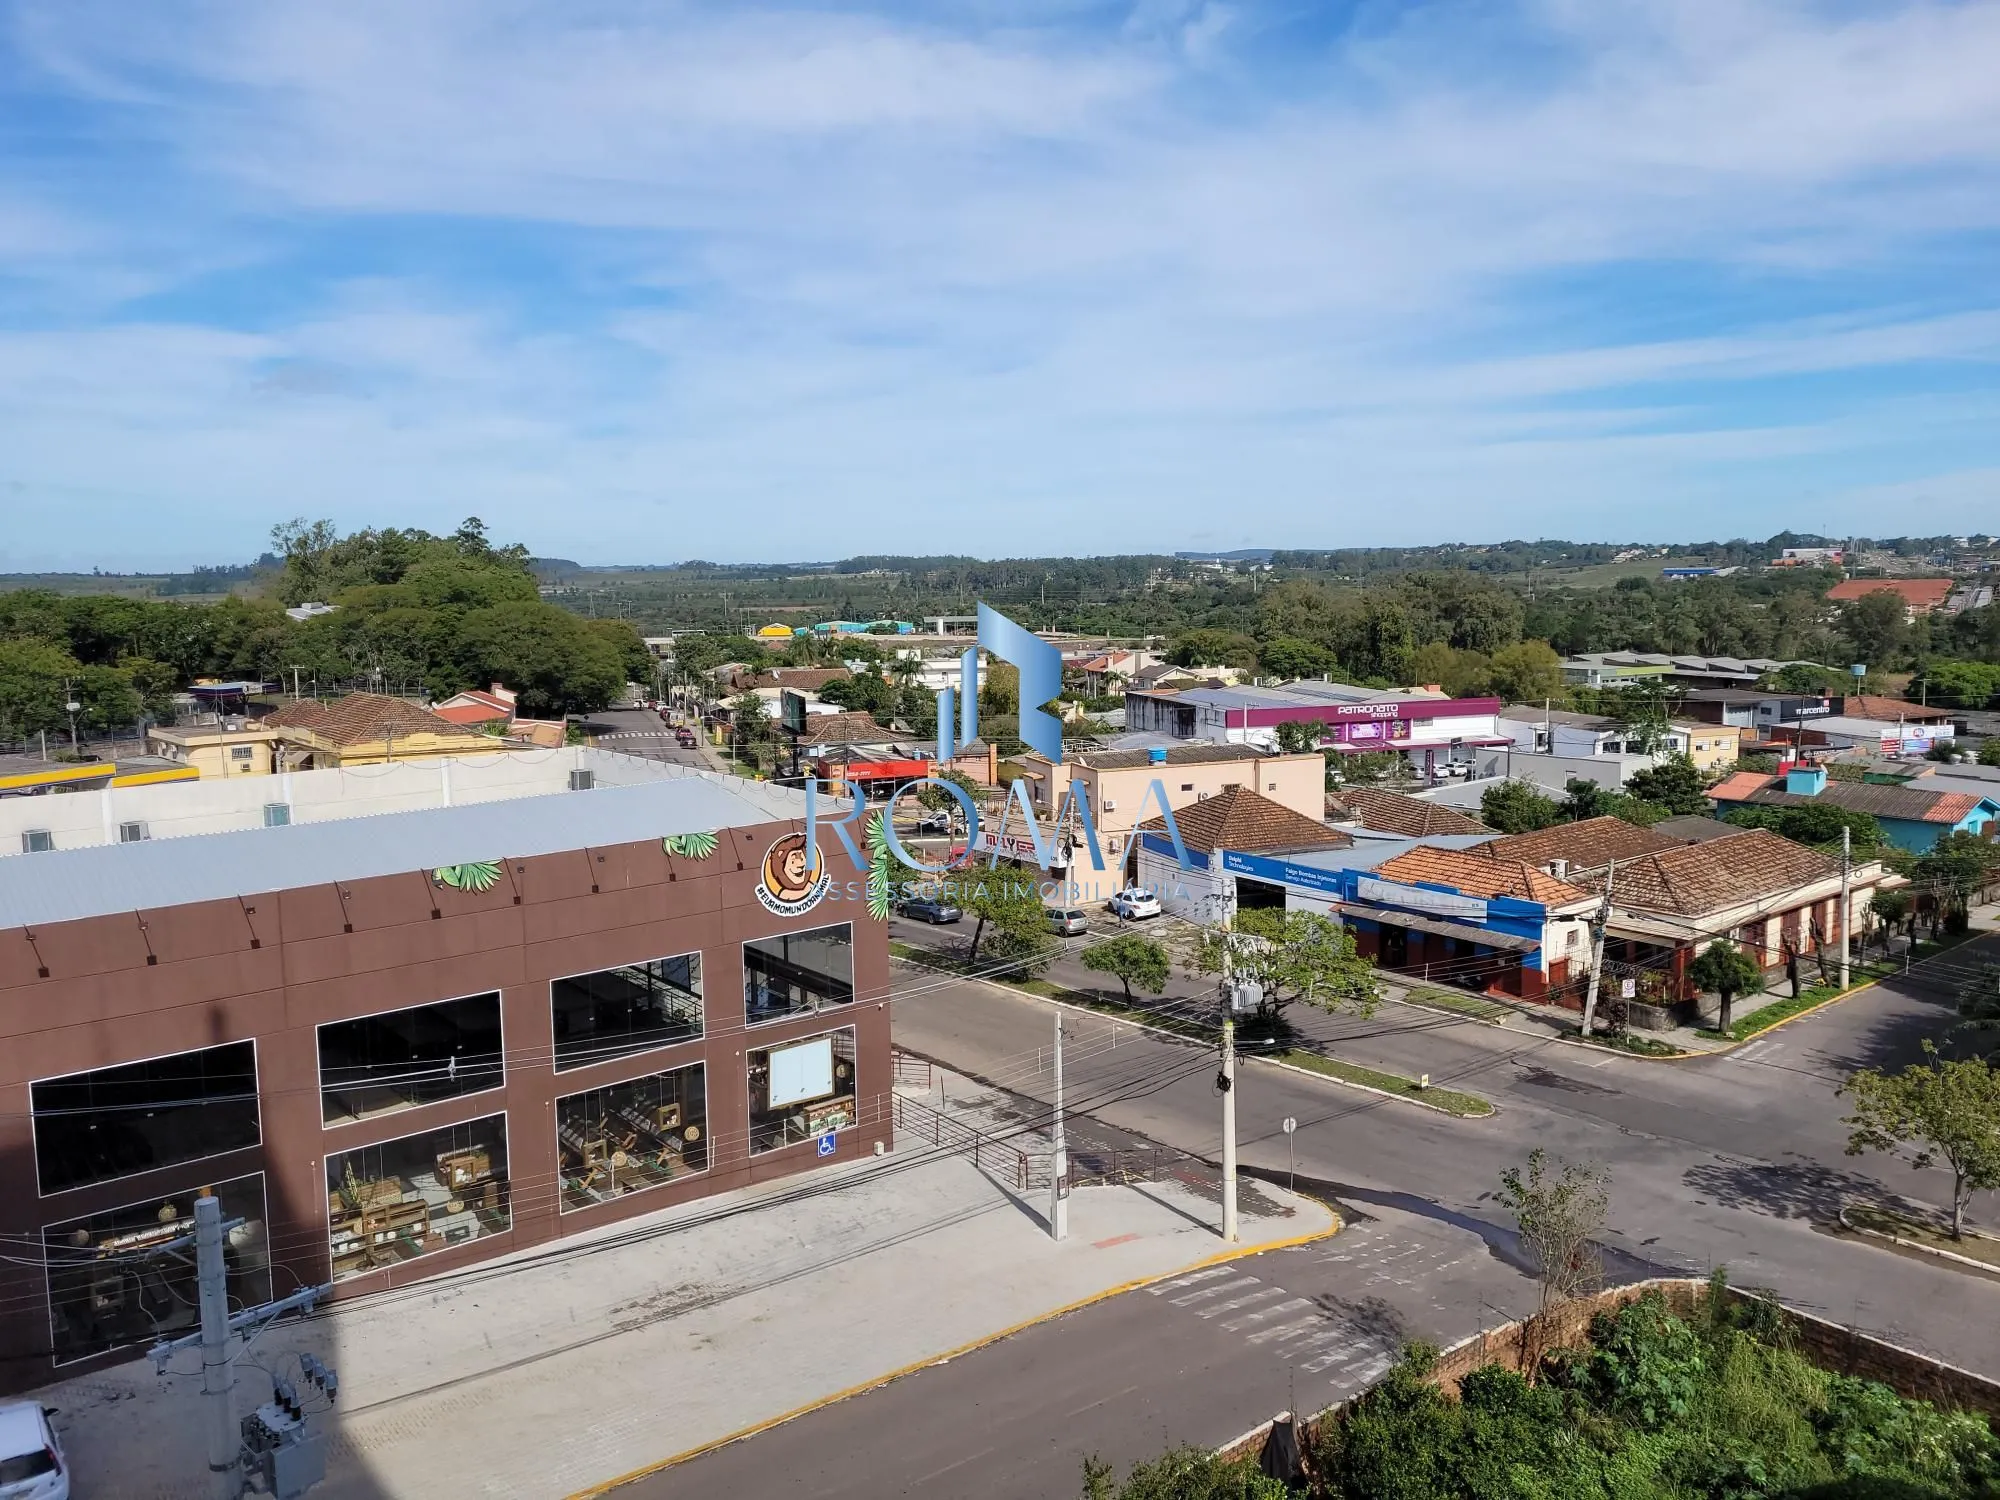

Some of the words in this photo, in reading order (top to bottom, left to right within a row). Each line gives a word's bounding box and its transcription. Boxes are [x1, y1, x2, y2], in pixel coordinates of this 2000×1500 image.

[1796, 706, 1830, 715] marcentro
[1229, 861, 1254, 871] Technologies
[1299, 870, 1317, 878] Bombas
